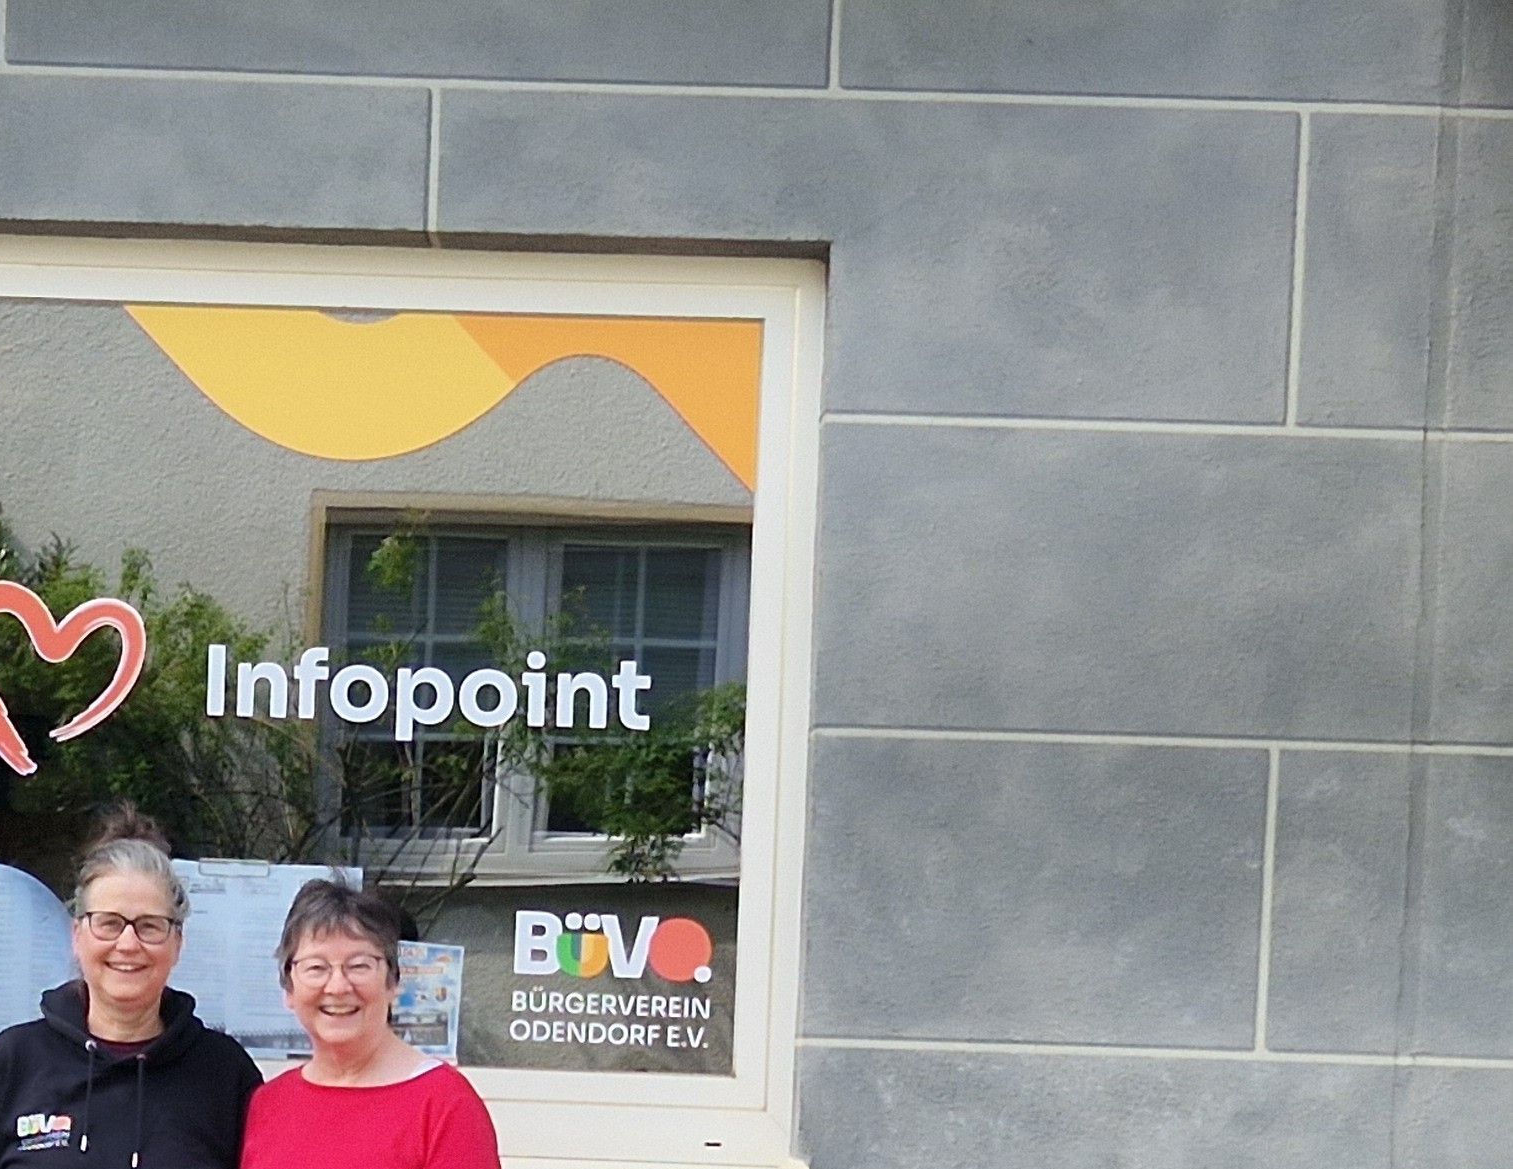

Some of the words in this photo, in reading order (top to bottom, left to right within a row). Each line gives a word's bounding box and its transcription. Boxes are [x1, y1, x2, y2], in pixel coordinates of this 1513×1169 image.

[206, 644, 651, 741] Infopoint
[511, 985, 710, 1020] BÜRGERVEREIN
[509, 1019, 661, 1046] ODENDORF
[666, 1025, 709, 1049] E.V.
